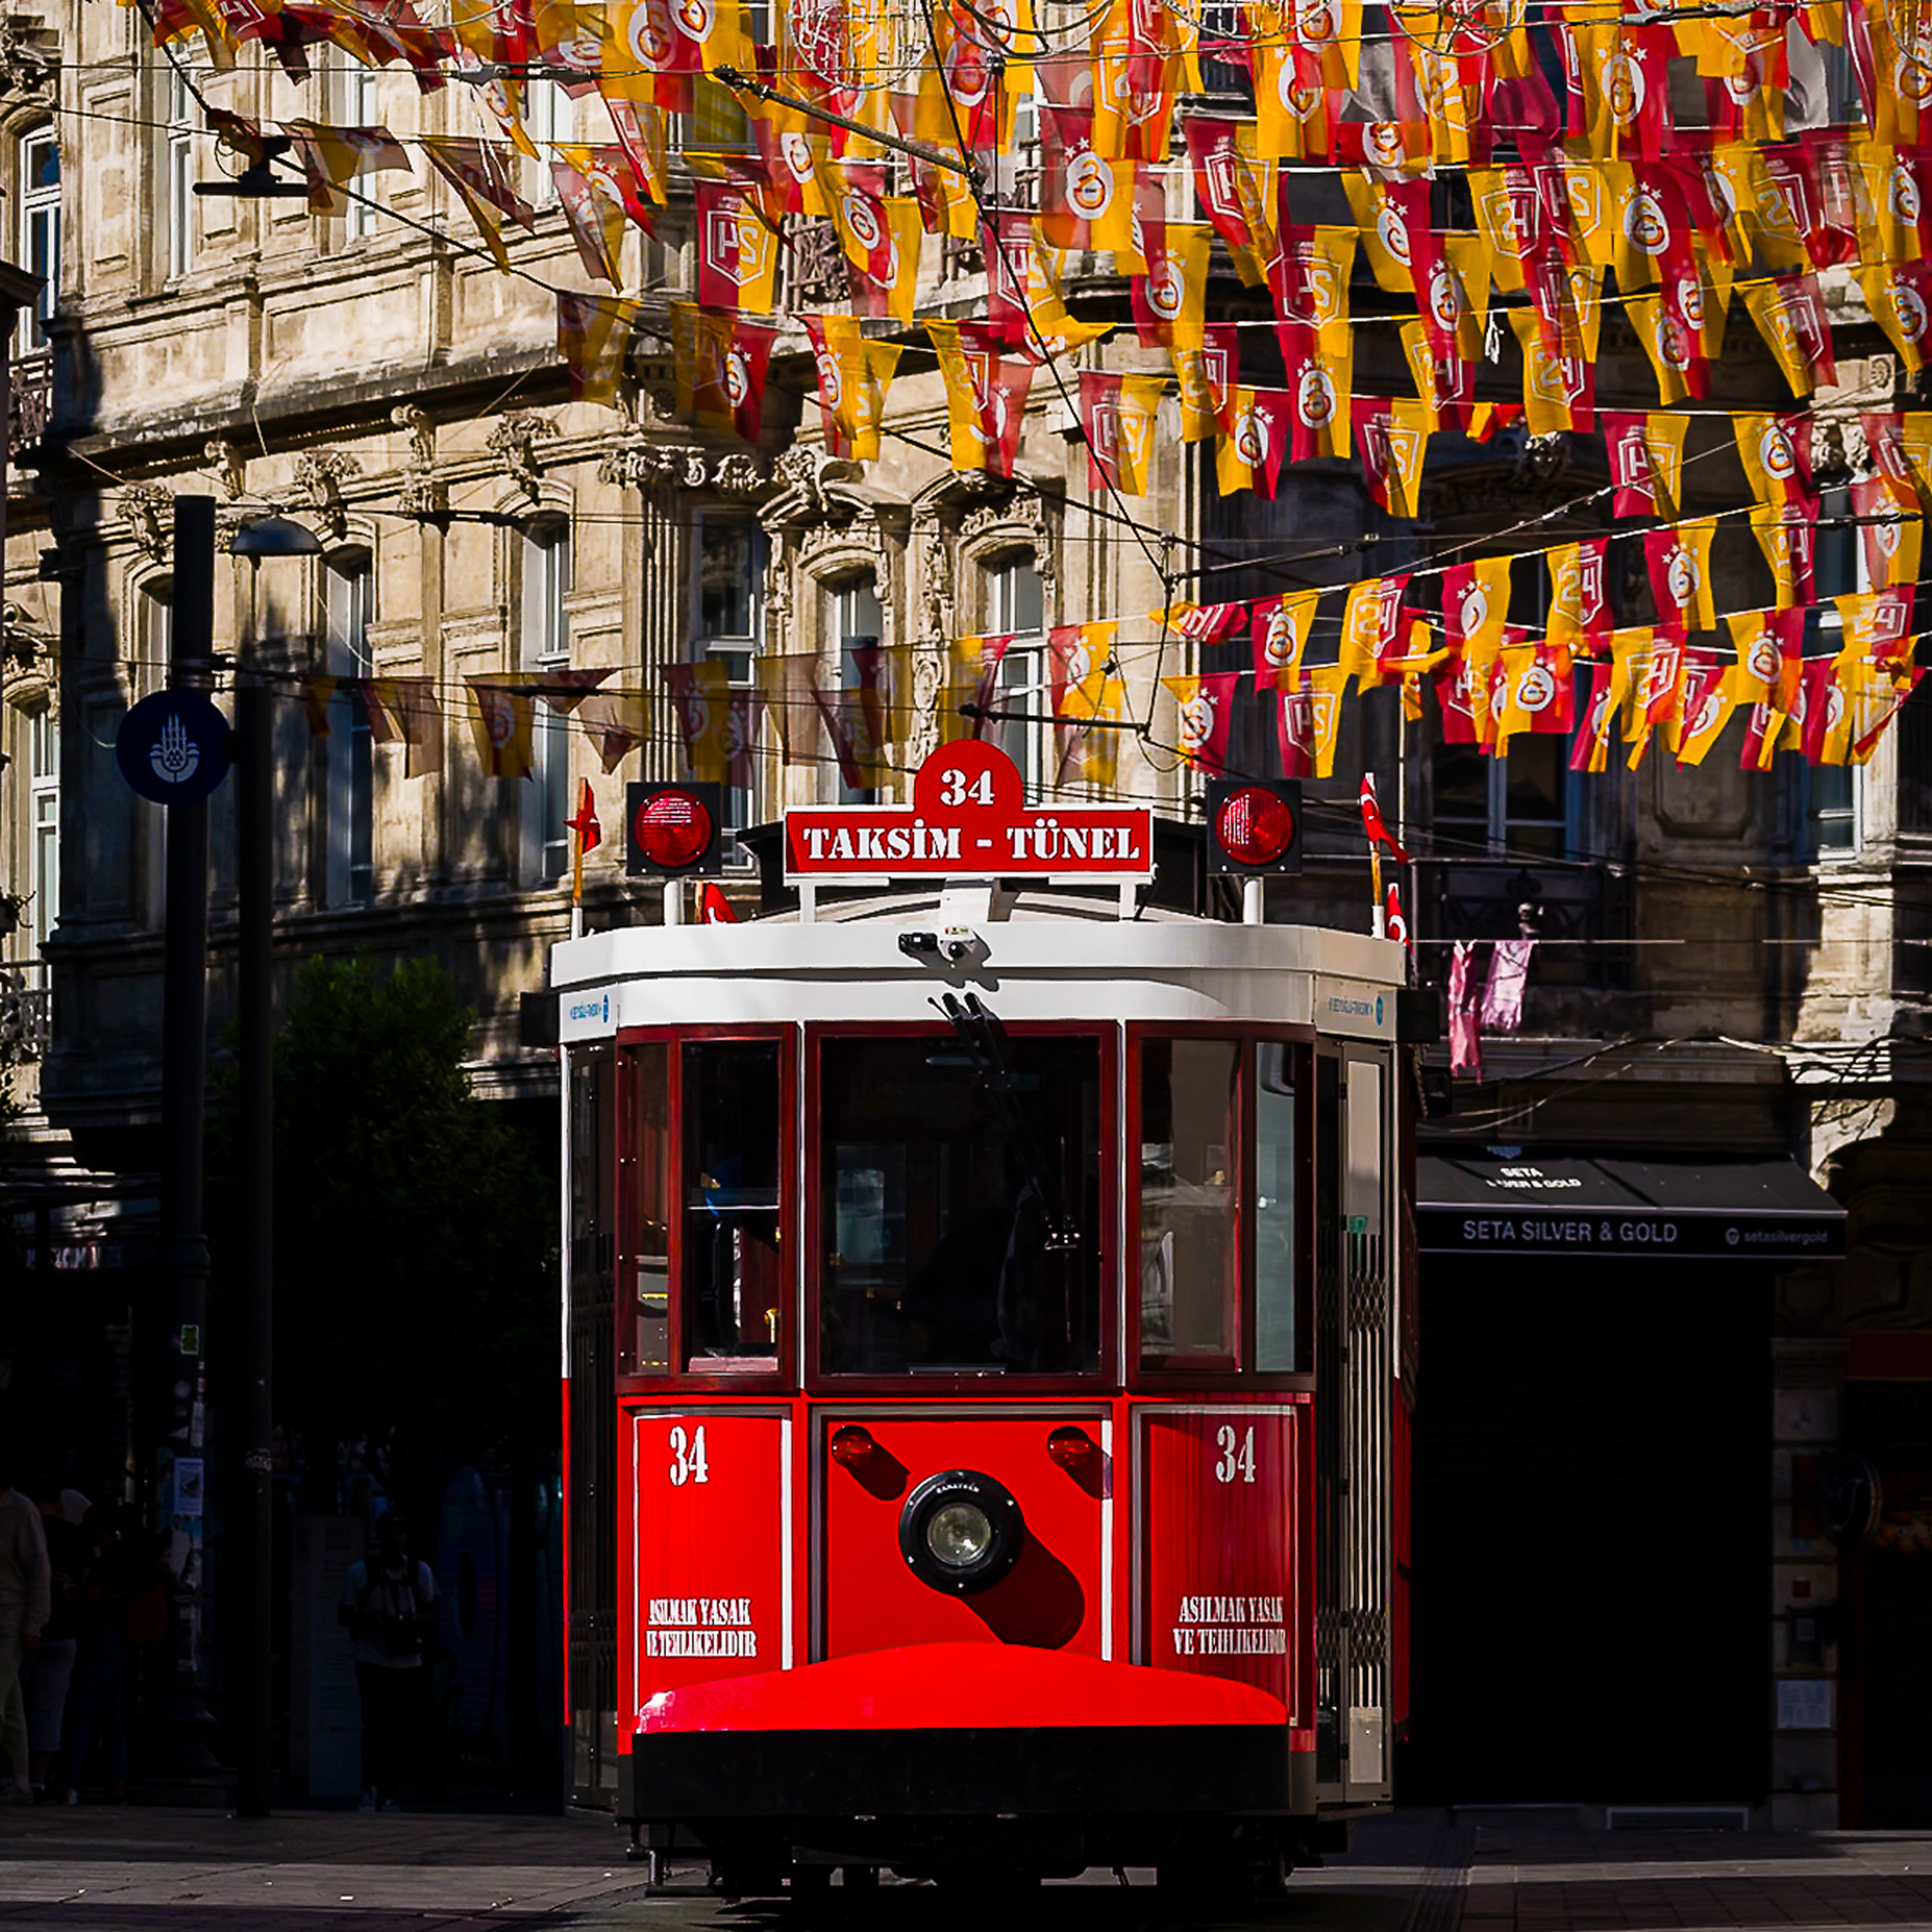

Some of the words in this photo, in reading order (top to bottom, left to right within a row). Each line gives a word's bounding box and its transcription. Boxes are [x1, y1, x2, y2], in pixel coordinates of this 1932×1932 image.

[1560, 566, 1596, 601] 24
[940, 769, 995, 807] 34
[803, 818, 962, 860] TAKSİM
[975, 838, 992, 848] -
[1007, 818, 1140, 860] TÜNEL
[1463, 1220, 1516, 1240] SETA
[1522, 1221, 1591, 1241] SILVER
[1599, 1222, 1613, 1241] &
[1620, 1223, 1677, 1242] GOLD
[669, 1424, 709, 1486] 34
[1215, 1424, 1257, 1483] 34
[699, 1598, 752, 1625] YASAK
[1178, 1595, 1245, 1623] ASILMAK
[1248, 1596, 1284, 1623] YASAK
[1173, 1628, 1195, 1655] VE
